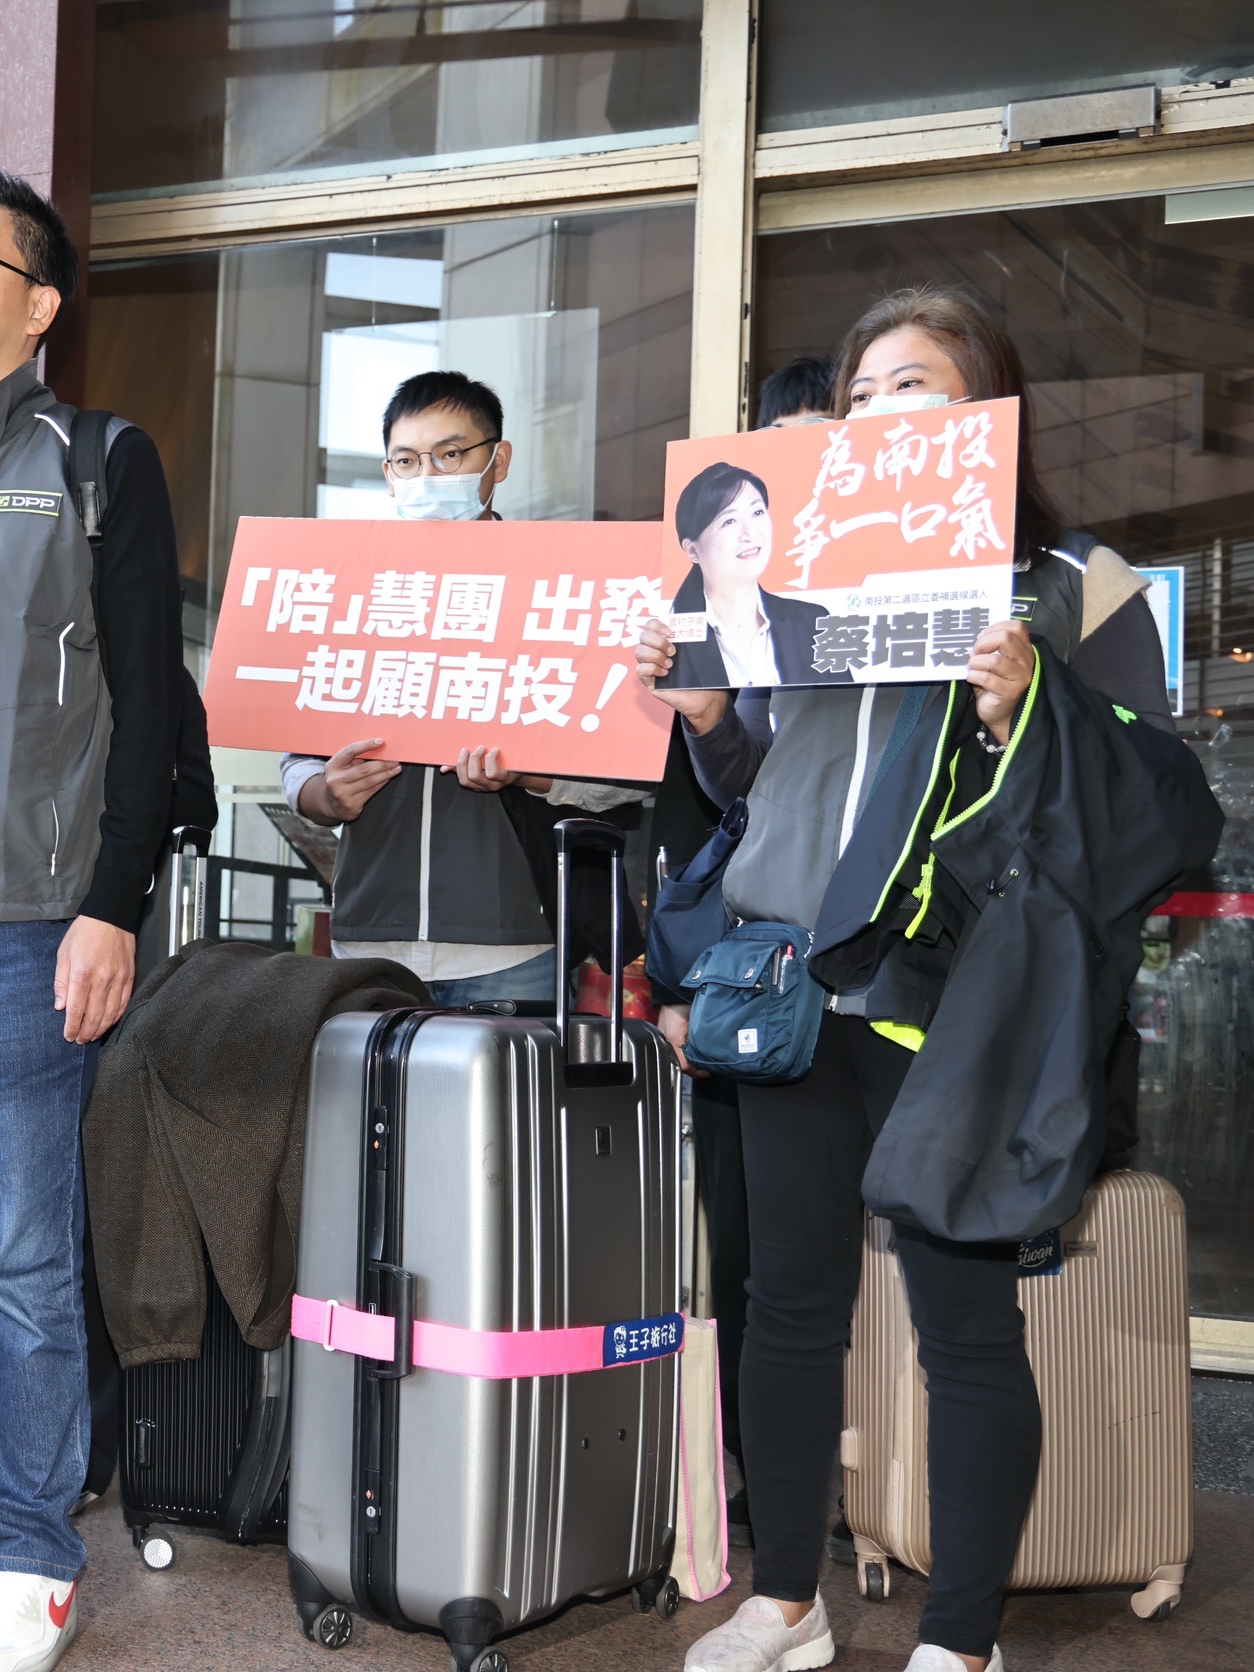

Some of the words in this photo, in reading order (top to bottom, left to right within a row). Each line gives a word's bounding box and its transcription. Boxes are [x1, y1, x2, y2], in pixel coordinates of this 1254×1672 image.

[813, 410, 996, 498] 為南投
[11, 495, 56, 509] DPP
[783, 474, 1006, 590] 爭一口氣
[240, 566, 506, 643] 「陪」慧團
[521, 573, 664, 649] 出發
[810, 606, 991, 674] 蔡培慧
[235, 644, 629, 733] 一起顧南投！
[1017, 1246, 1053, 1265] aiwan
[629, 1322, 677, 1352] 王子旅行社
